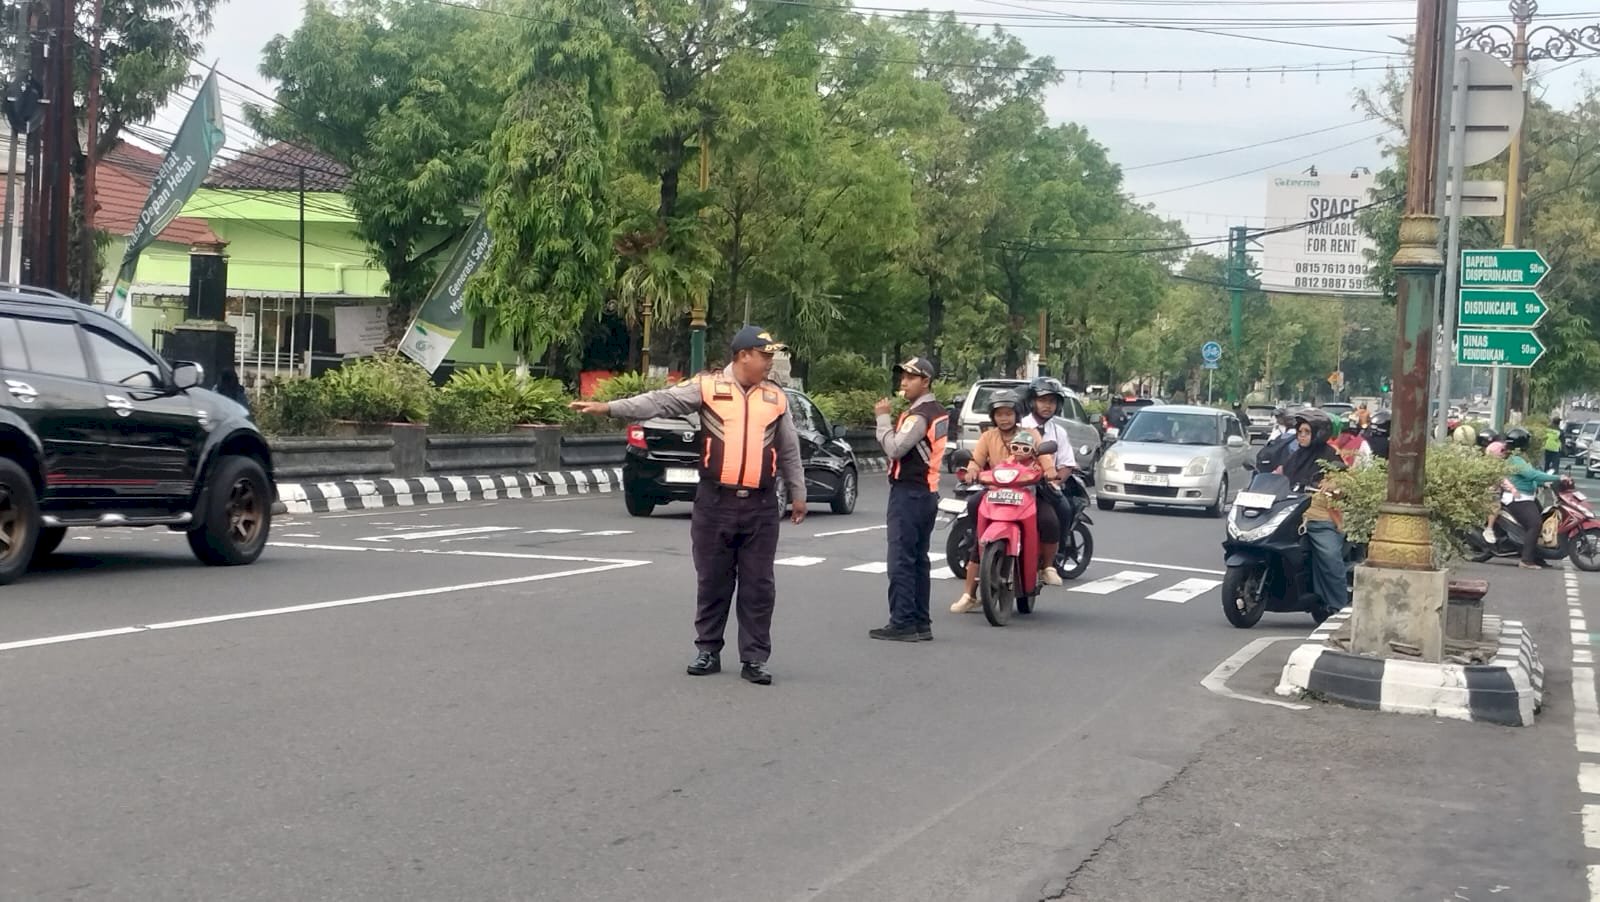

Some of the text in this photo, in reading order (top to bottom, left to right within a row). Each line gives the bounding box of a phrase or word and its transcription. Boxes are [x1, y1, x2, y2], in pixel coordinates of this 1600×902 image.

[141, 188, 171, 225] Depan
[167, 155, 196, 191] Hebat
[1309, 197, 1359, 220] SPACE
[1307, 222, 1357, 236] AVAILABLE
[1307, 238, 1357, 253] FOR RENT
[1295, 262, 1320, 273] 0815
[1322, 263, 1346, 274] 7613
[1529, 263, 1544, 274] 50m
[448, 256, 476, 297] Generasi
[1294, 277, 1319, 287] 0812
[1464, 301, 1540, 315] DISDUKCAPIL 50m
[1463, 335, 1488, 347] DINAS
[1521, 343, 1536, 354] 50m
